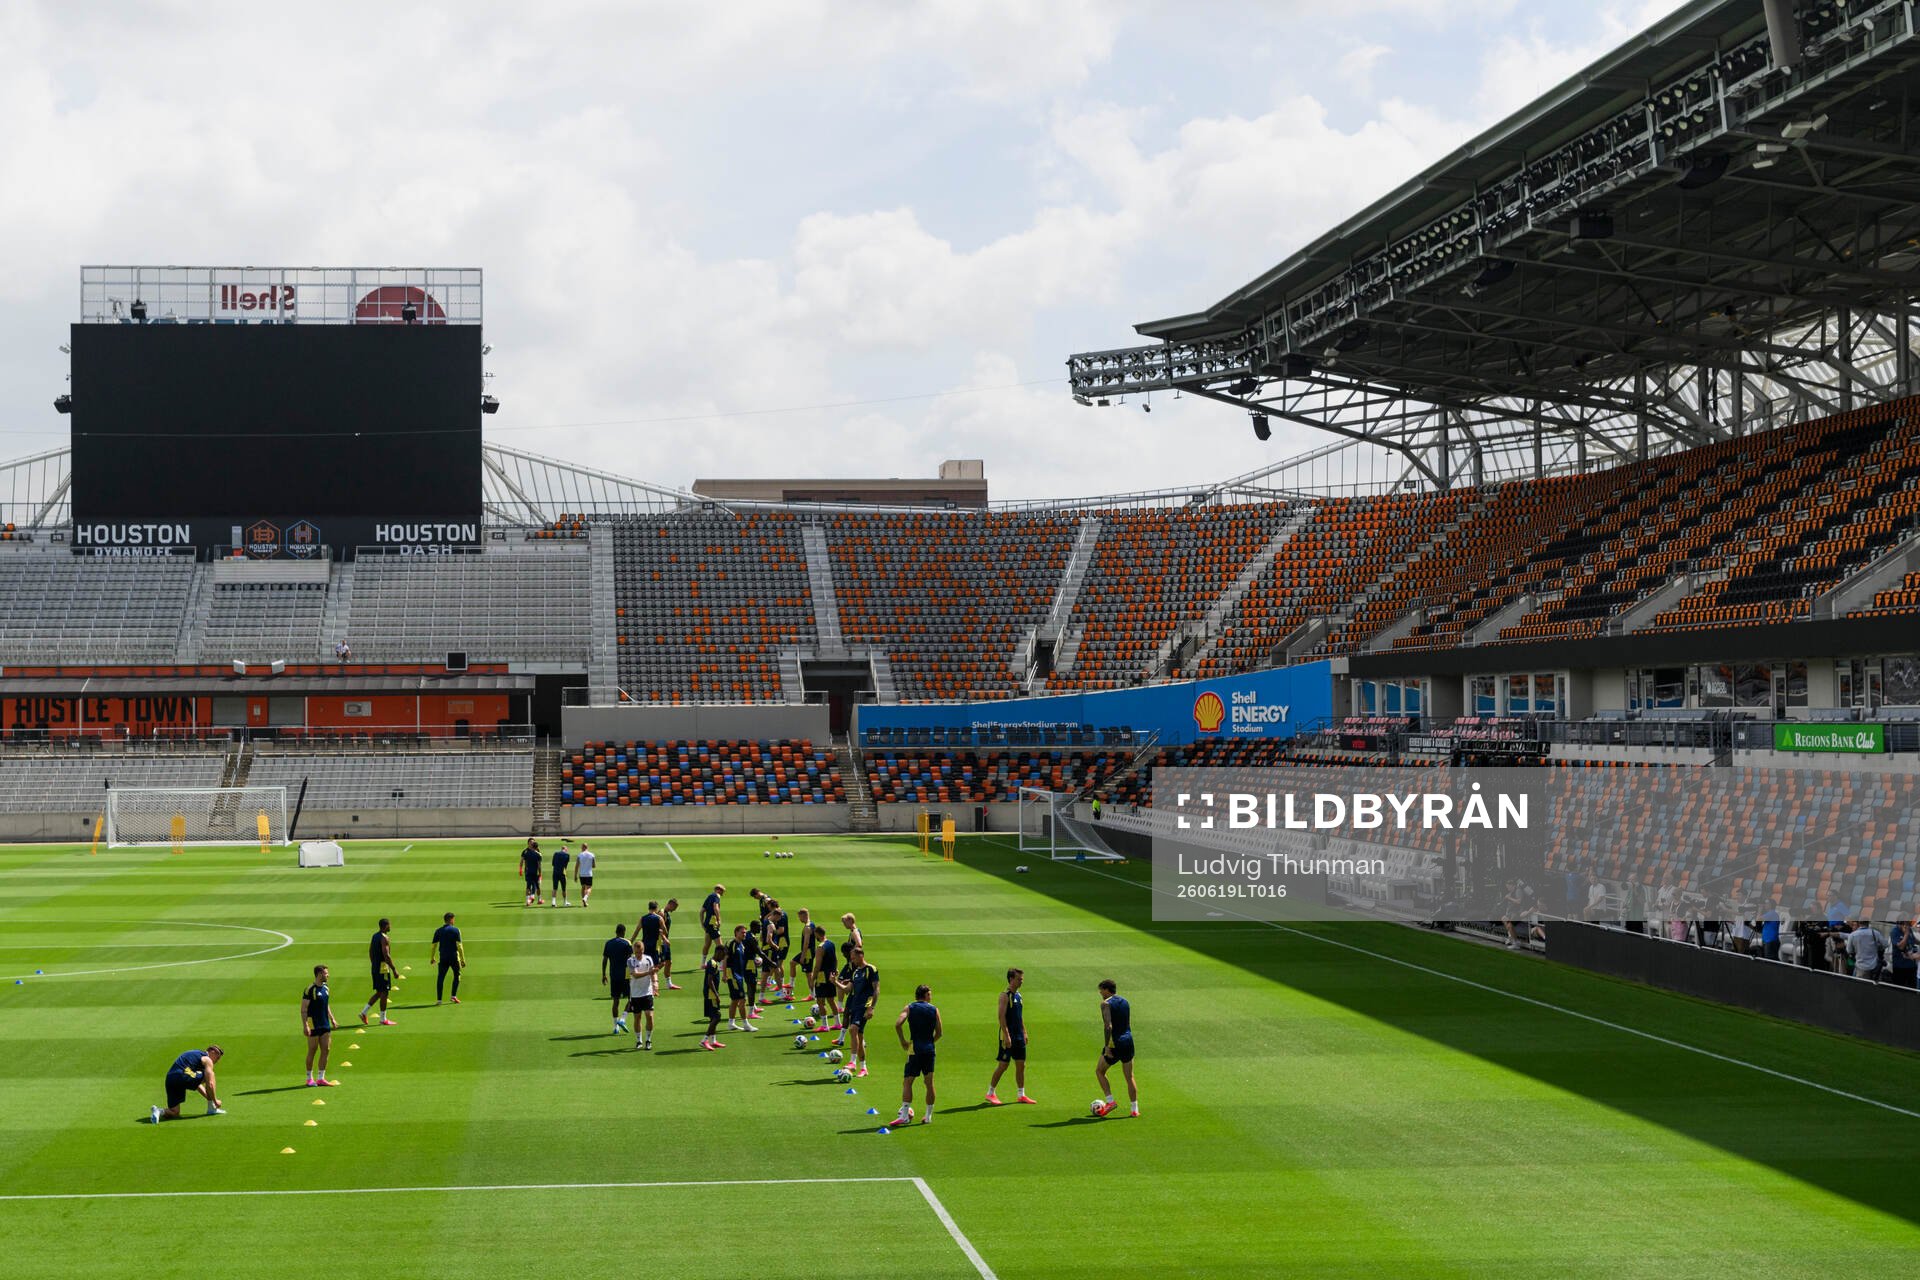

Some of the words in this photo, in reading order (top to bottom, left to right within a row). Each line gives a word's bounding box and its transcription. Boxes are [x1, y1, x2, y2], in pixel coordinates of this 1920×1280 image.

[77, 524, 190, 544] HOUSTON
[376, 524, 476, 542] HOUSTON
[95, 546, 153, 557] DYNAMO
[156, 546, 173, 557] FC
[400, 544, 453, 556] DASH
[1231, 691, 1256, 704] Shell
[16, 696, 110, 723] HUSTLE
[121, 696, 195, 723] TOWN
[1231, 705, 1289, 722] ENERGY
[1232, 724, 1263, 733] Stadium
[1795, 732, 1830, 748] REGIONS
[1831, 733, 1854, 748] BANK
[1856, 732, 1875, 749] Club
